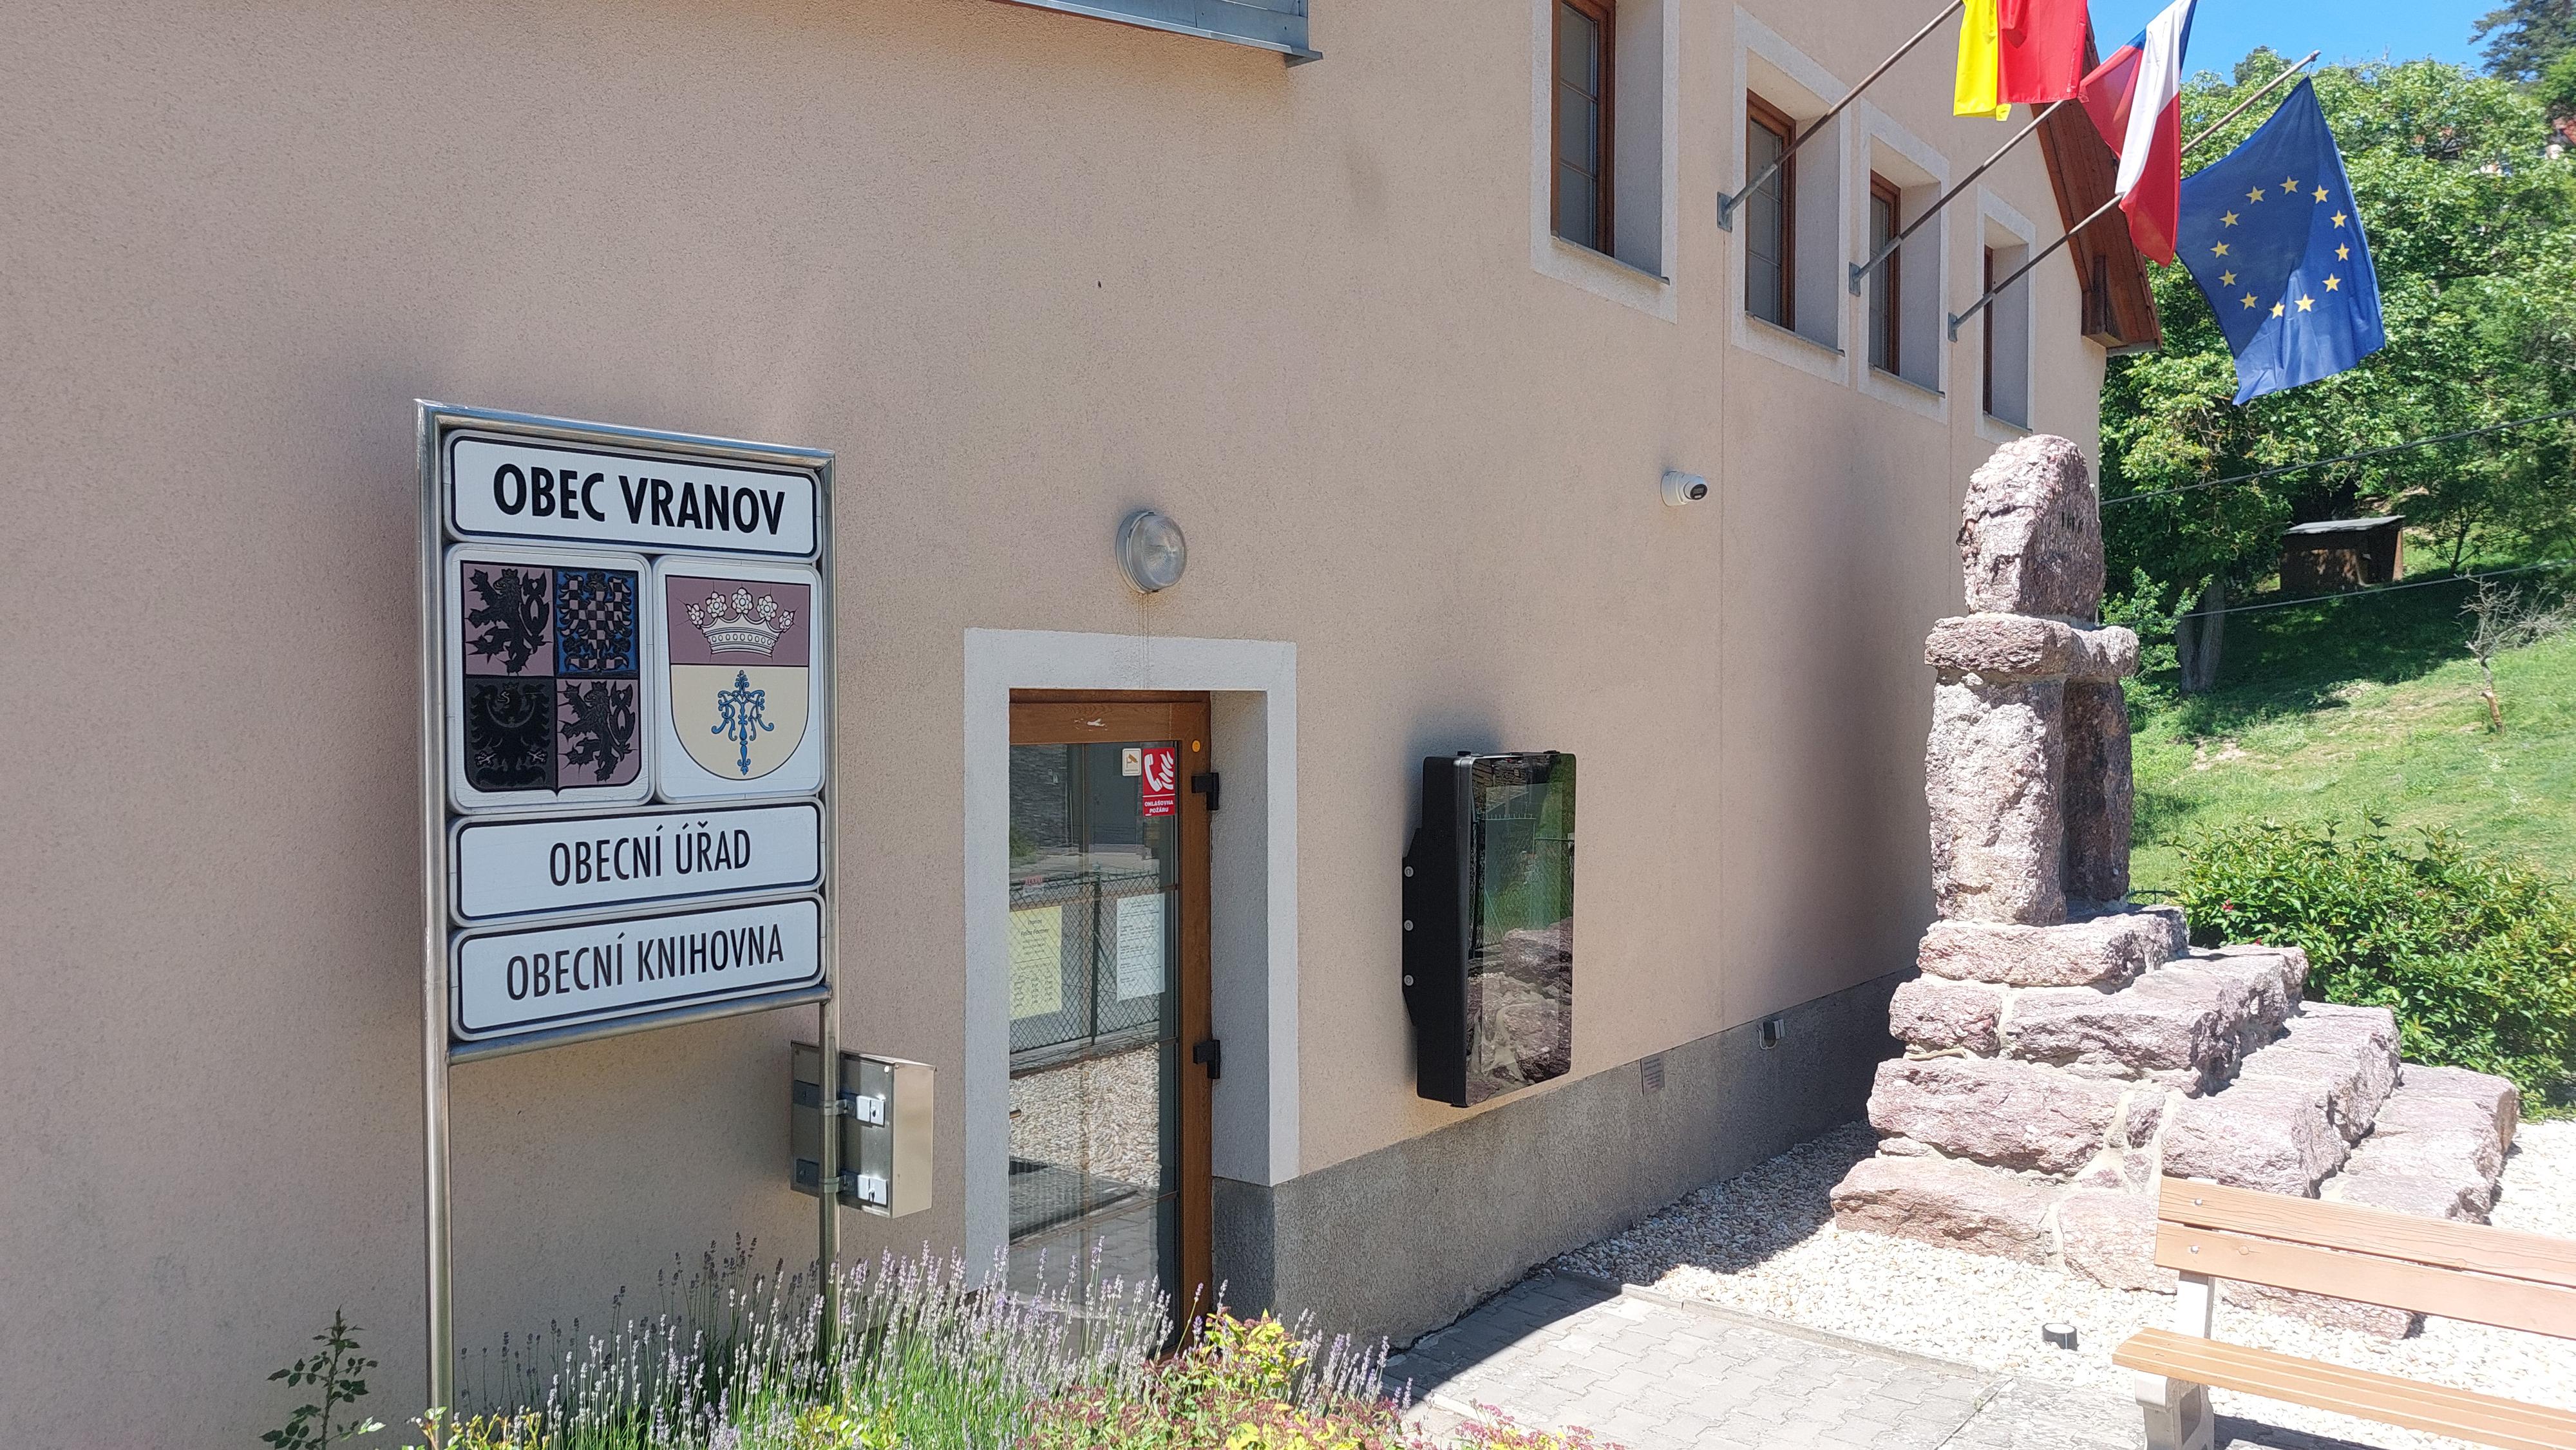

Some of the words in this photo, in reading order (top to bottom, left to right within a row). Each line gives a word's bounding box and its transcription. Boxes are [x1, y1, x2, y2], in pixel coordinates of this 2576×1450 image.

[493, 463, 605, 522] OBEC
[618, 475, 786, 535] VRANOV
[549, 824, 663, 887] OBECNÍ
[676, 820, 750, 874] ÚŘAD
[507, 932, 625, 1001] OBECNÍ
[638, 923, 784, 983] KNIHOVNA
